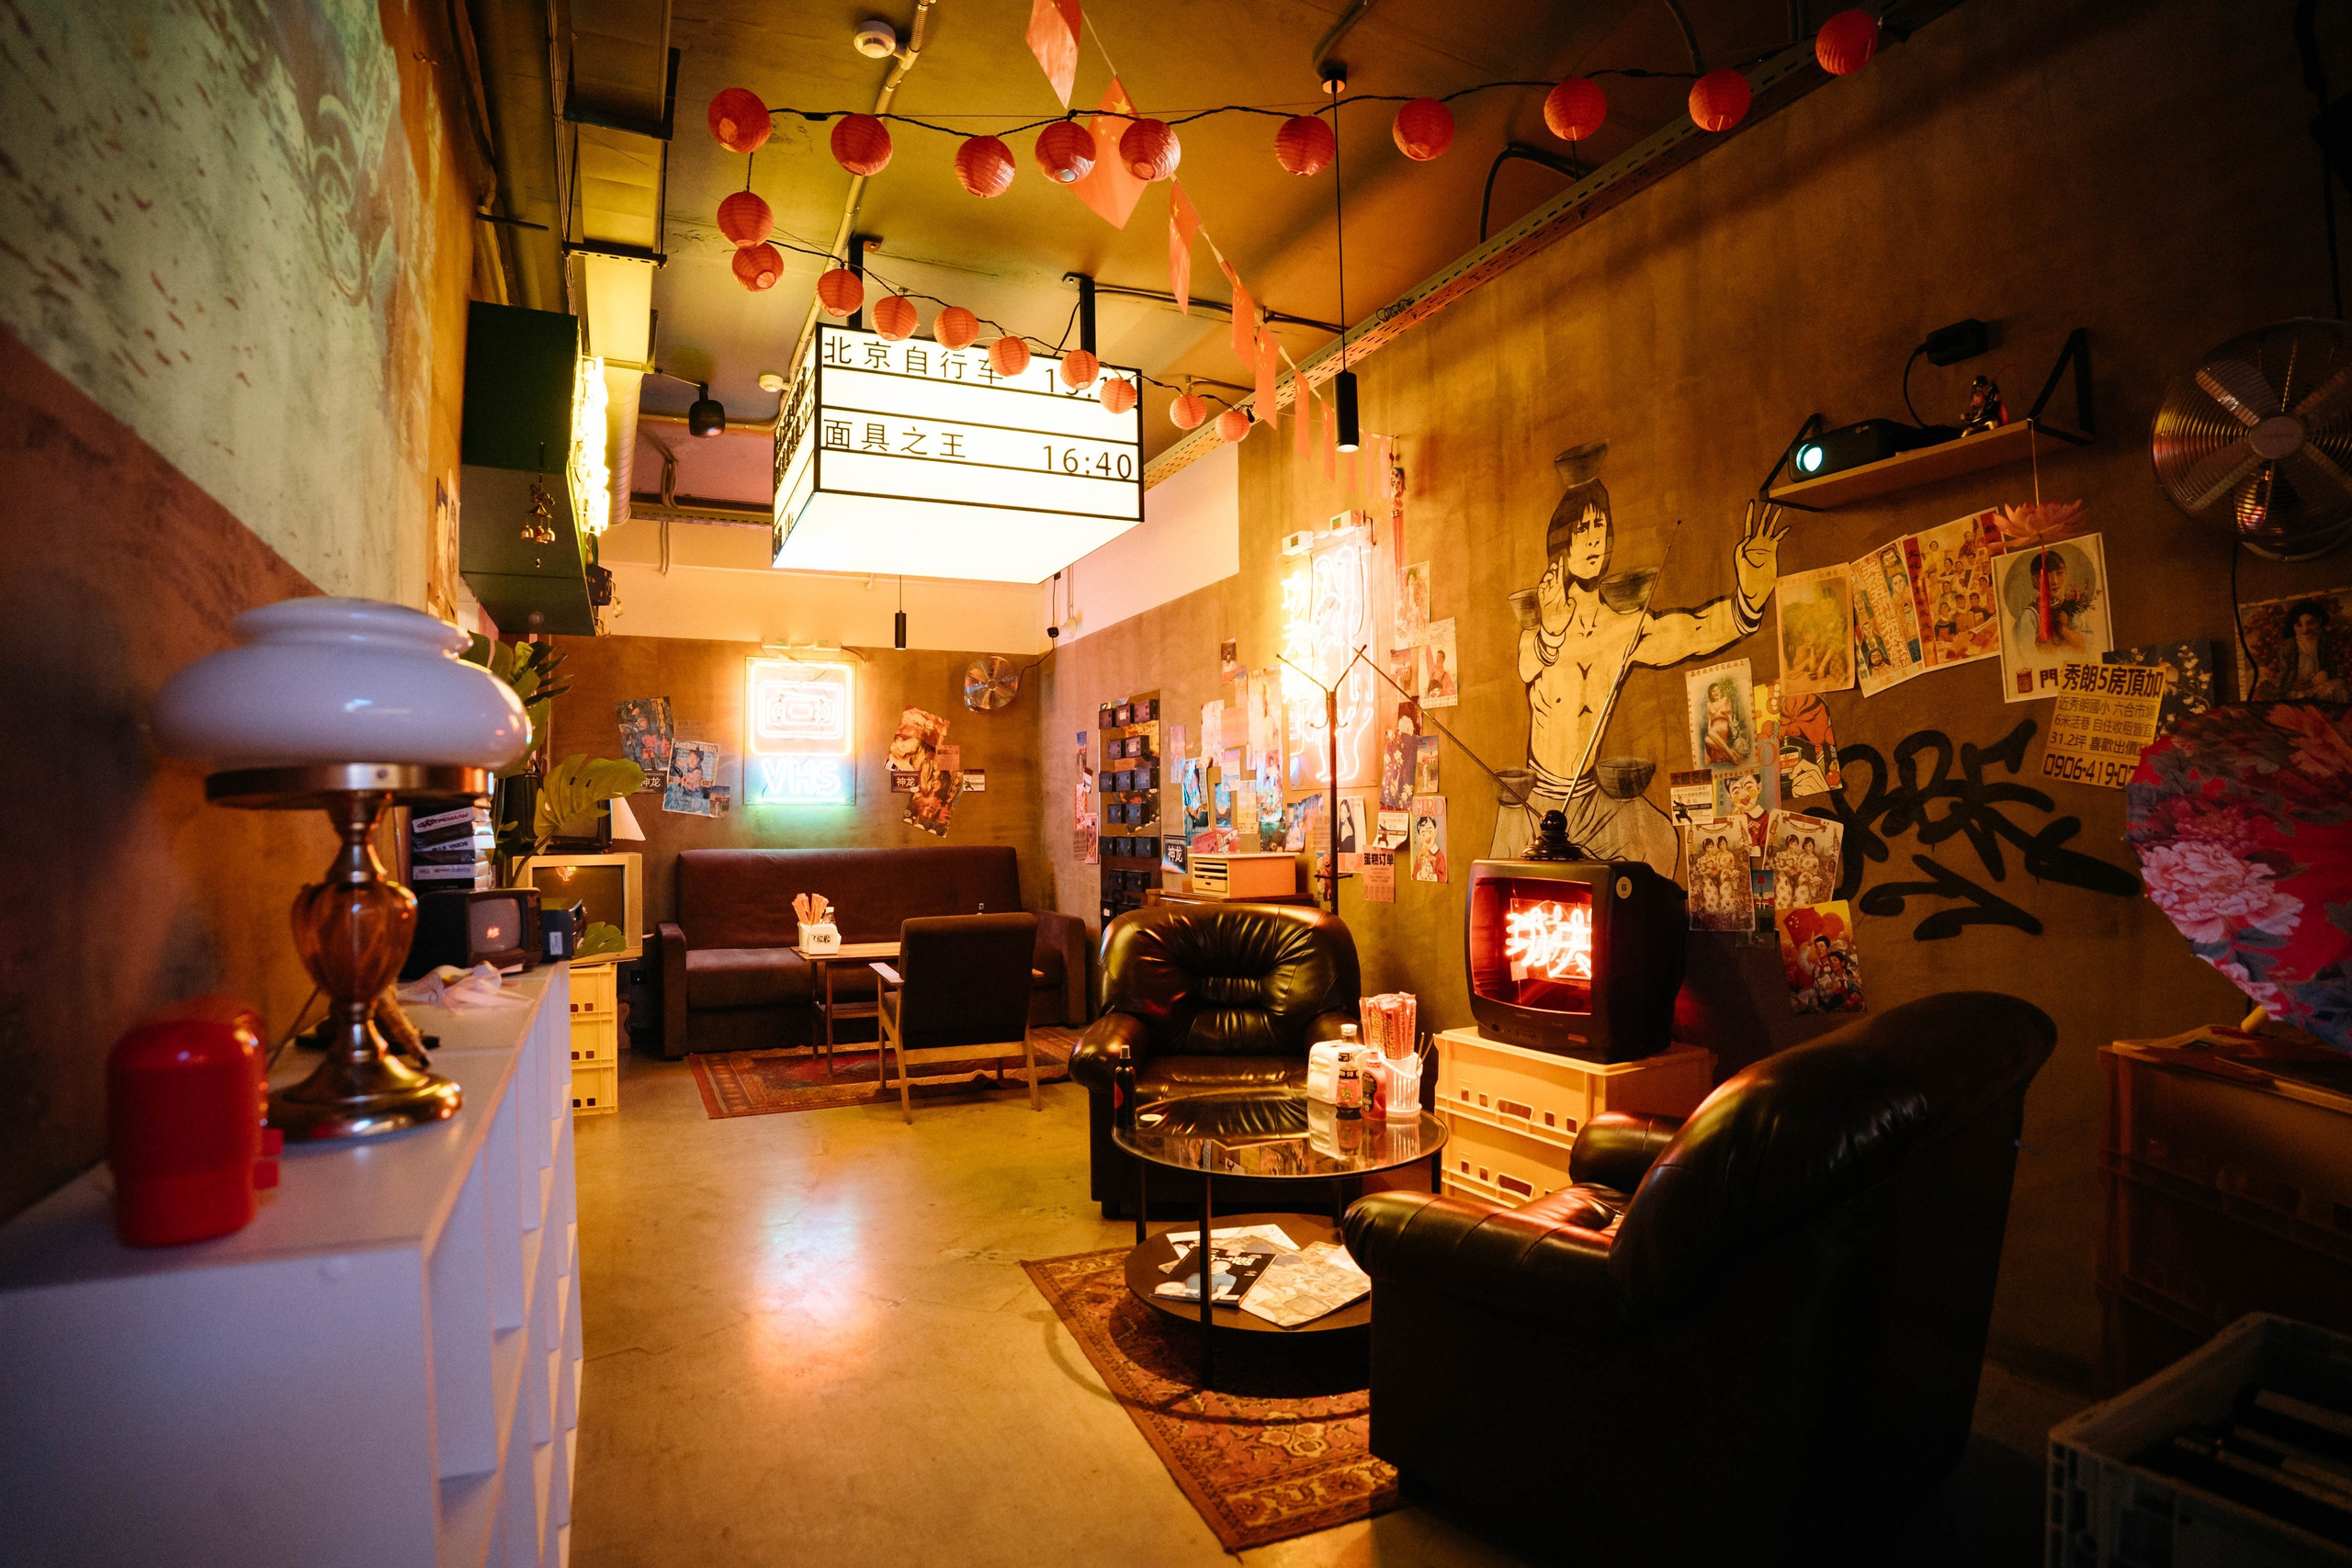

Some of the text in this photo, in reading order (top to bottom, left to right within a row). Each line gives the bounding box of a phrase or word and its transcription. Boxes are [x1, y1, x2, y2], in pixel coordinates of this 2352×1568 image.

[823, 335, 1003, 385] 北京自行车
[823, 419, 967, 458] 面具之王
[1043, 445, 1133, 480] 16:40
[2062, 663, 2165, 698] 秀朗5房頂加
[2058, 695, 2157, 721] 近秀朗國小 六合市場
[2092, 717, 2154, 739] 自住收租皆宜
[2050, 731, 2087, 750] 31.2坪
[761, 756, 842, 796] VHS
[896, 777, 916, 787] 神龙
[1411, 798, 1445, 818] GIRO
[1167, 845, 1183, 863] 神龙
[1363, 852, 1394, 866] 蛋糕订单
